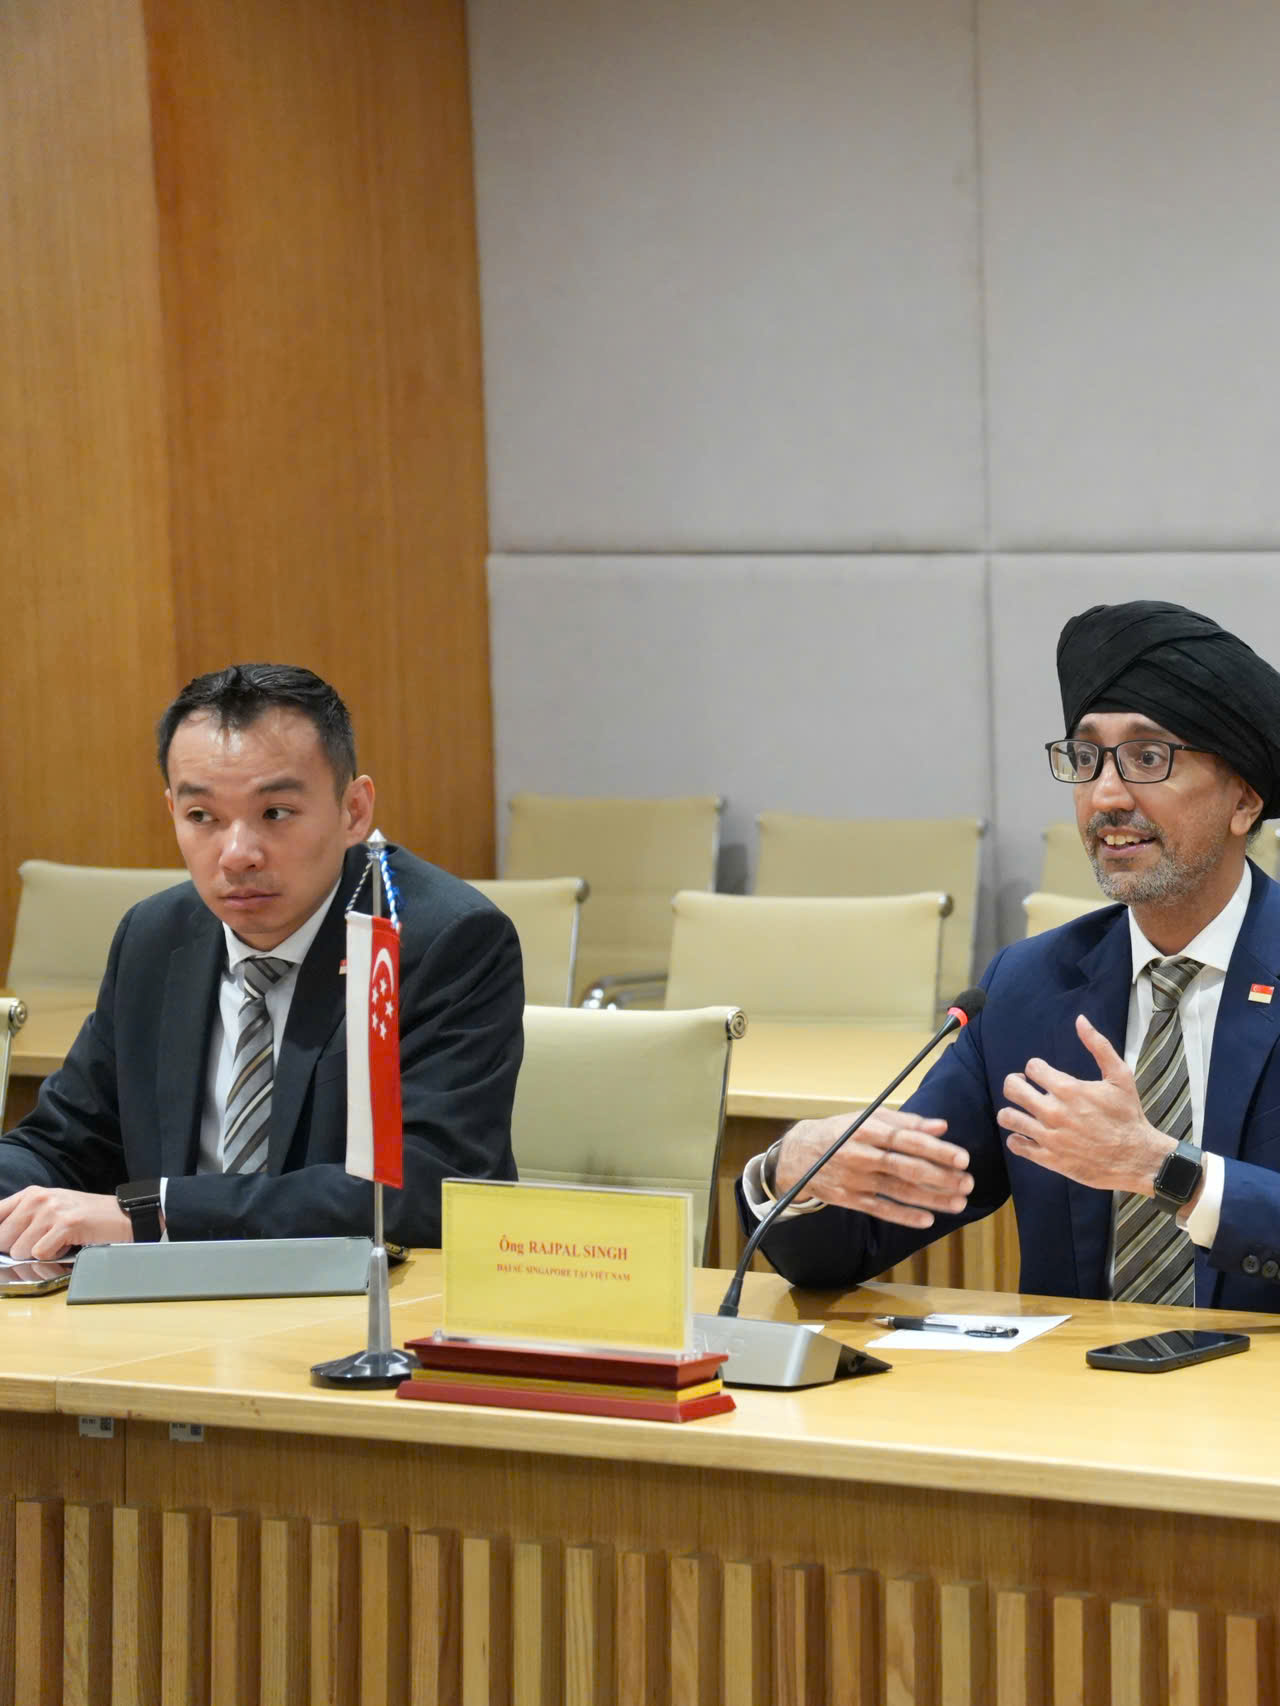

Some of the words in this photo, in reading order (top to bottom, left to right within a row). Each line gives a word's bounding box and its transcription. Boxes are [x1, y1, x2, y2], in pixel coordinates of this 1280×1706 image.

[499, 1234, 524, 1255] Ông
[529, 1240, 580, 1257] RAJPAL
[584, 1244, 627, 1261] SINGH
[525, 1266, 570, 1277] SINGAPORE
